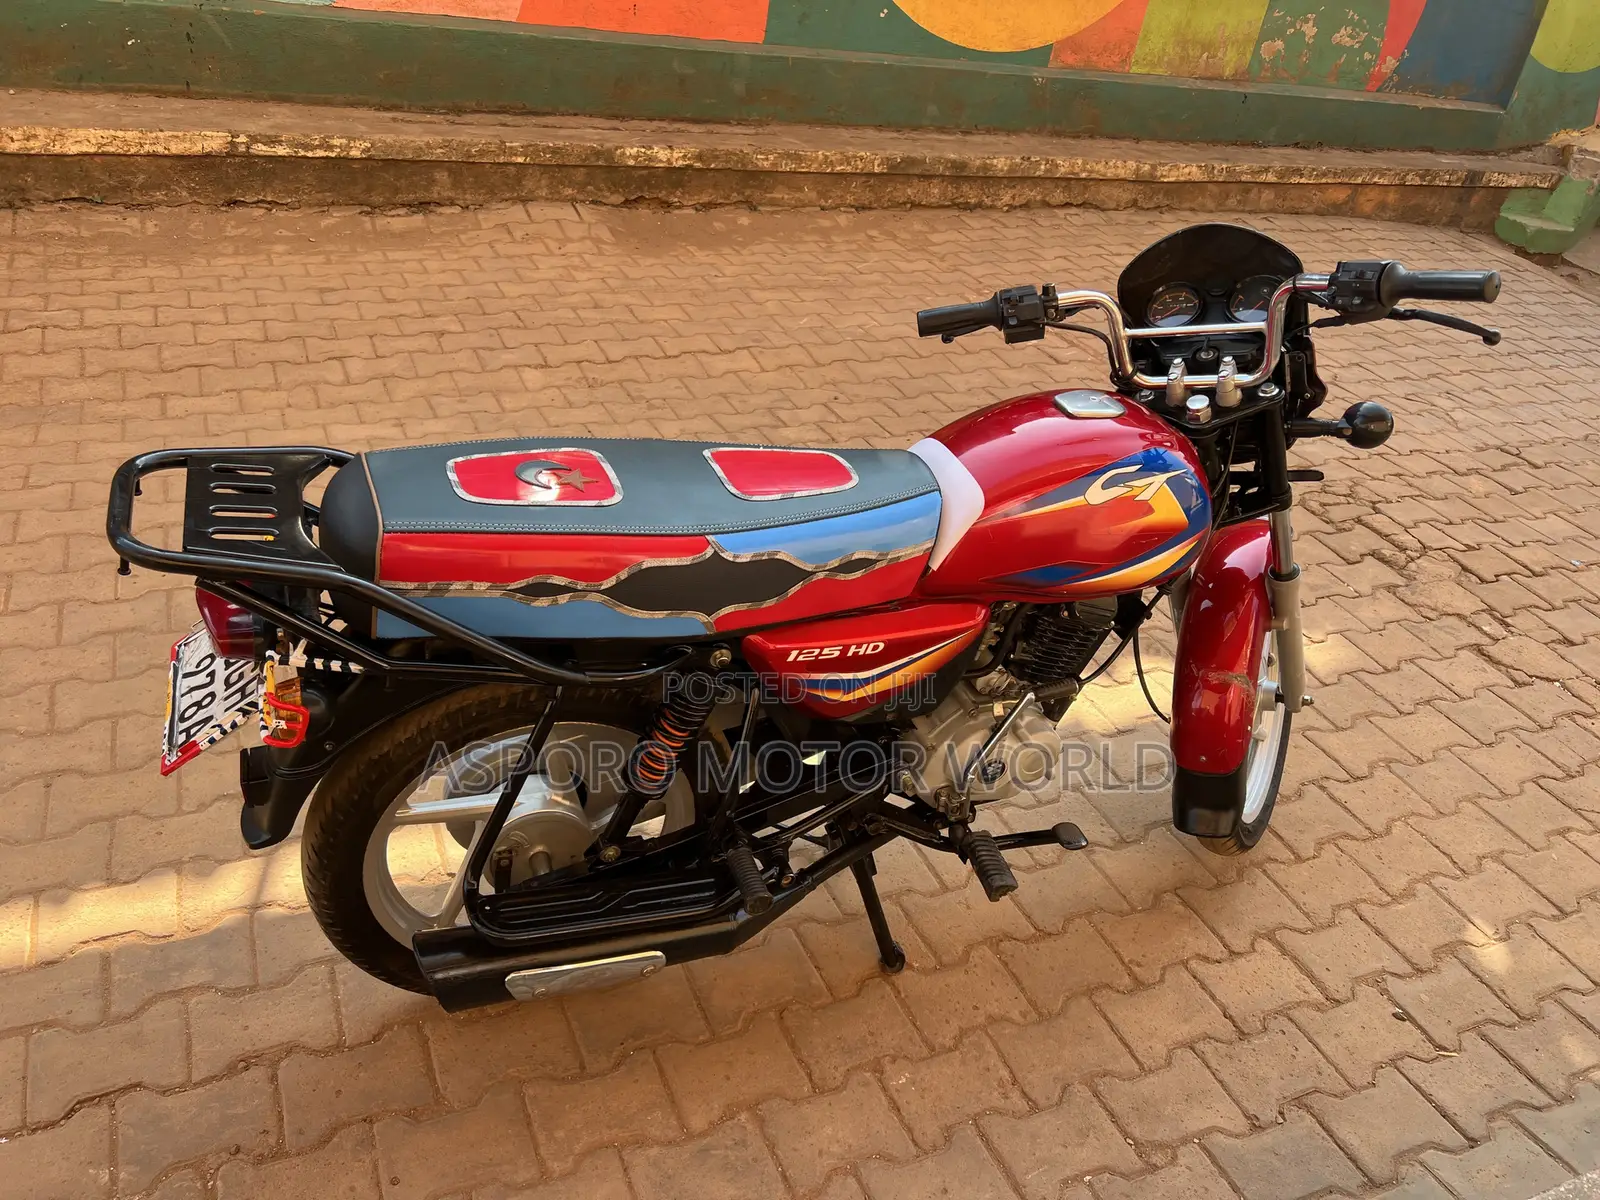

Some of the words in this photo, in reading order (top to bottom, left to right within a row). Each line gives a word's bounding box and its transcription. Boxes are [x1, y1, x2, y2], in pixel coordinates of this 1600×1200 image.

[786, 646, 843, 662] 125
[846, 641, 885, 657] HD
[178, 652, 217, 748] 978A
